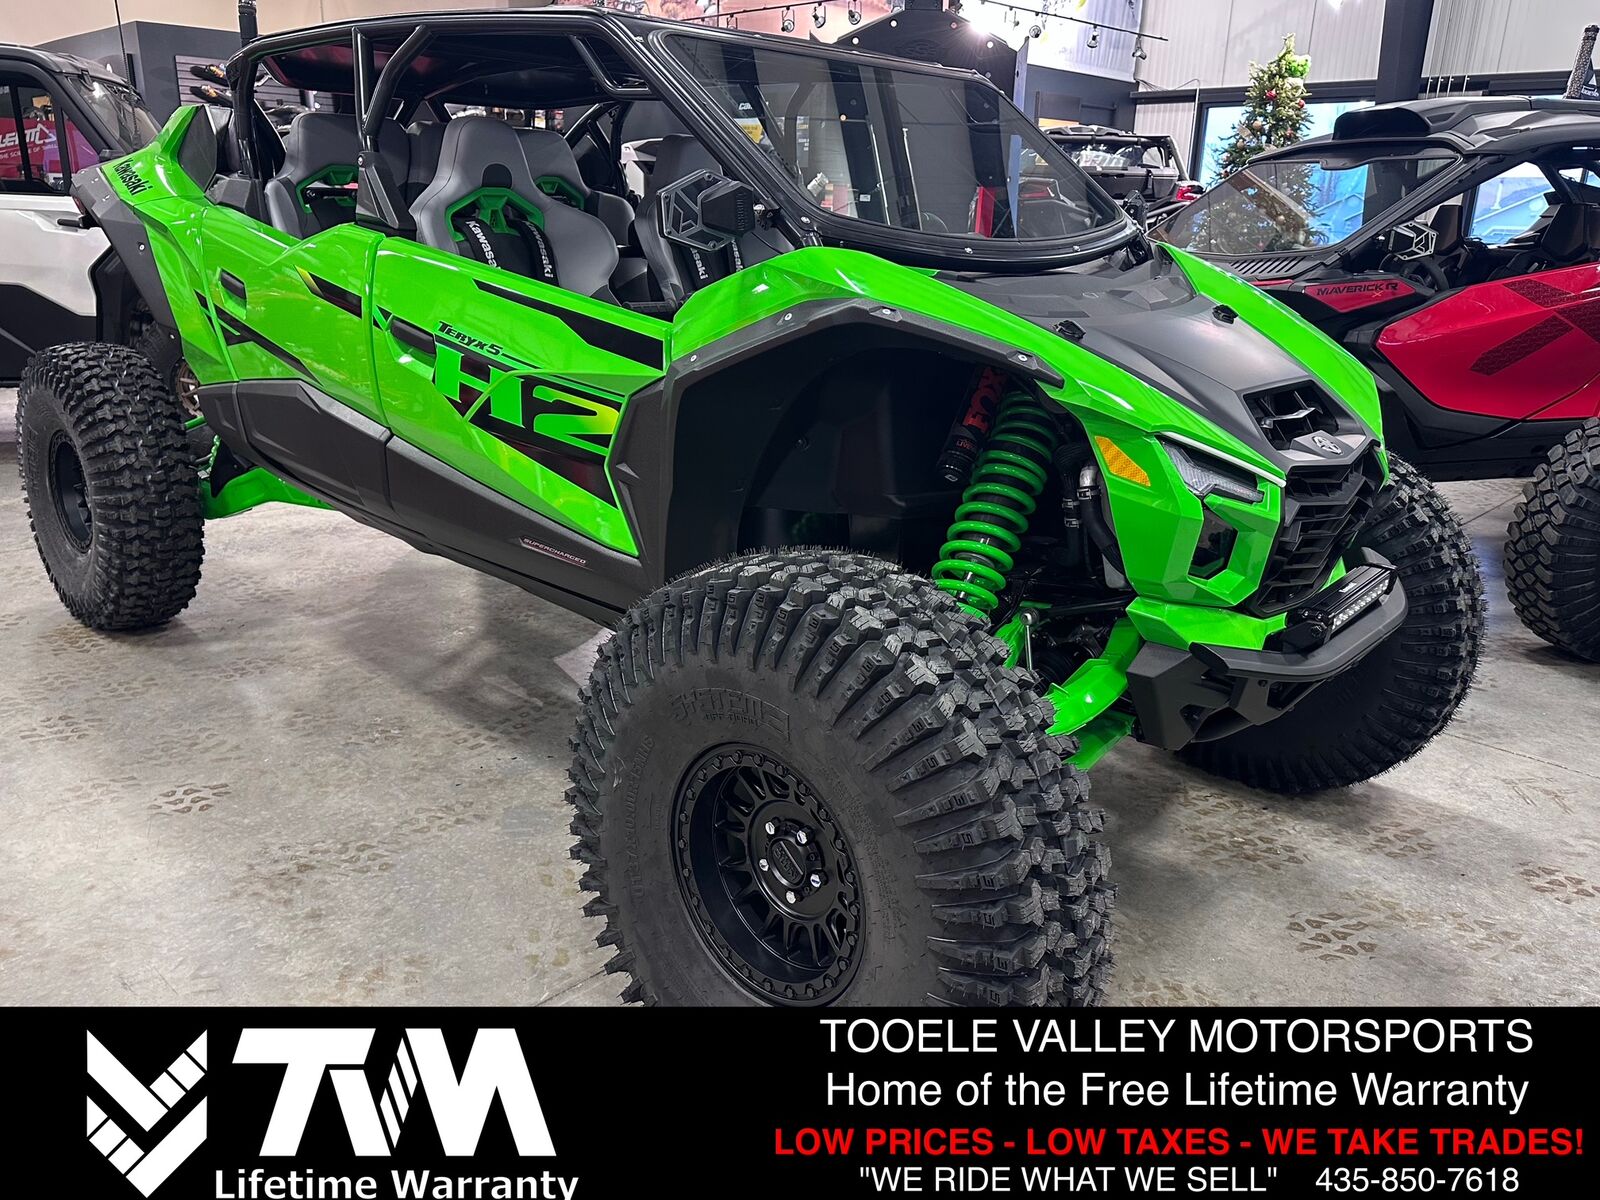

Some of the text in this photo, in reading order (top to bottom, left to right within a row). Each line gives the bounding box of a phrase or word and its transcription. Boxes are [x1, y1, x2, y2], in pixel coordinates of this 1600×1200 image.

[113, 158, 153, 196] Kawasaki
[465, 220, 501, 269] Kawasa
[1316, 283, 1384, 296] MAVERICK
[434, 341, 620, 457] H2
[523, 538, 586, 564] SUPERCHARGED
